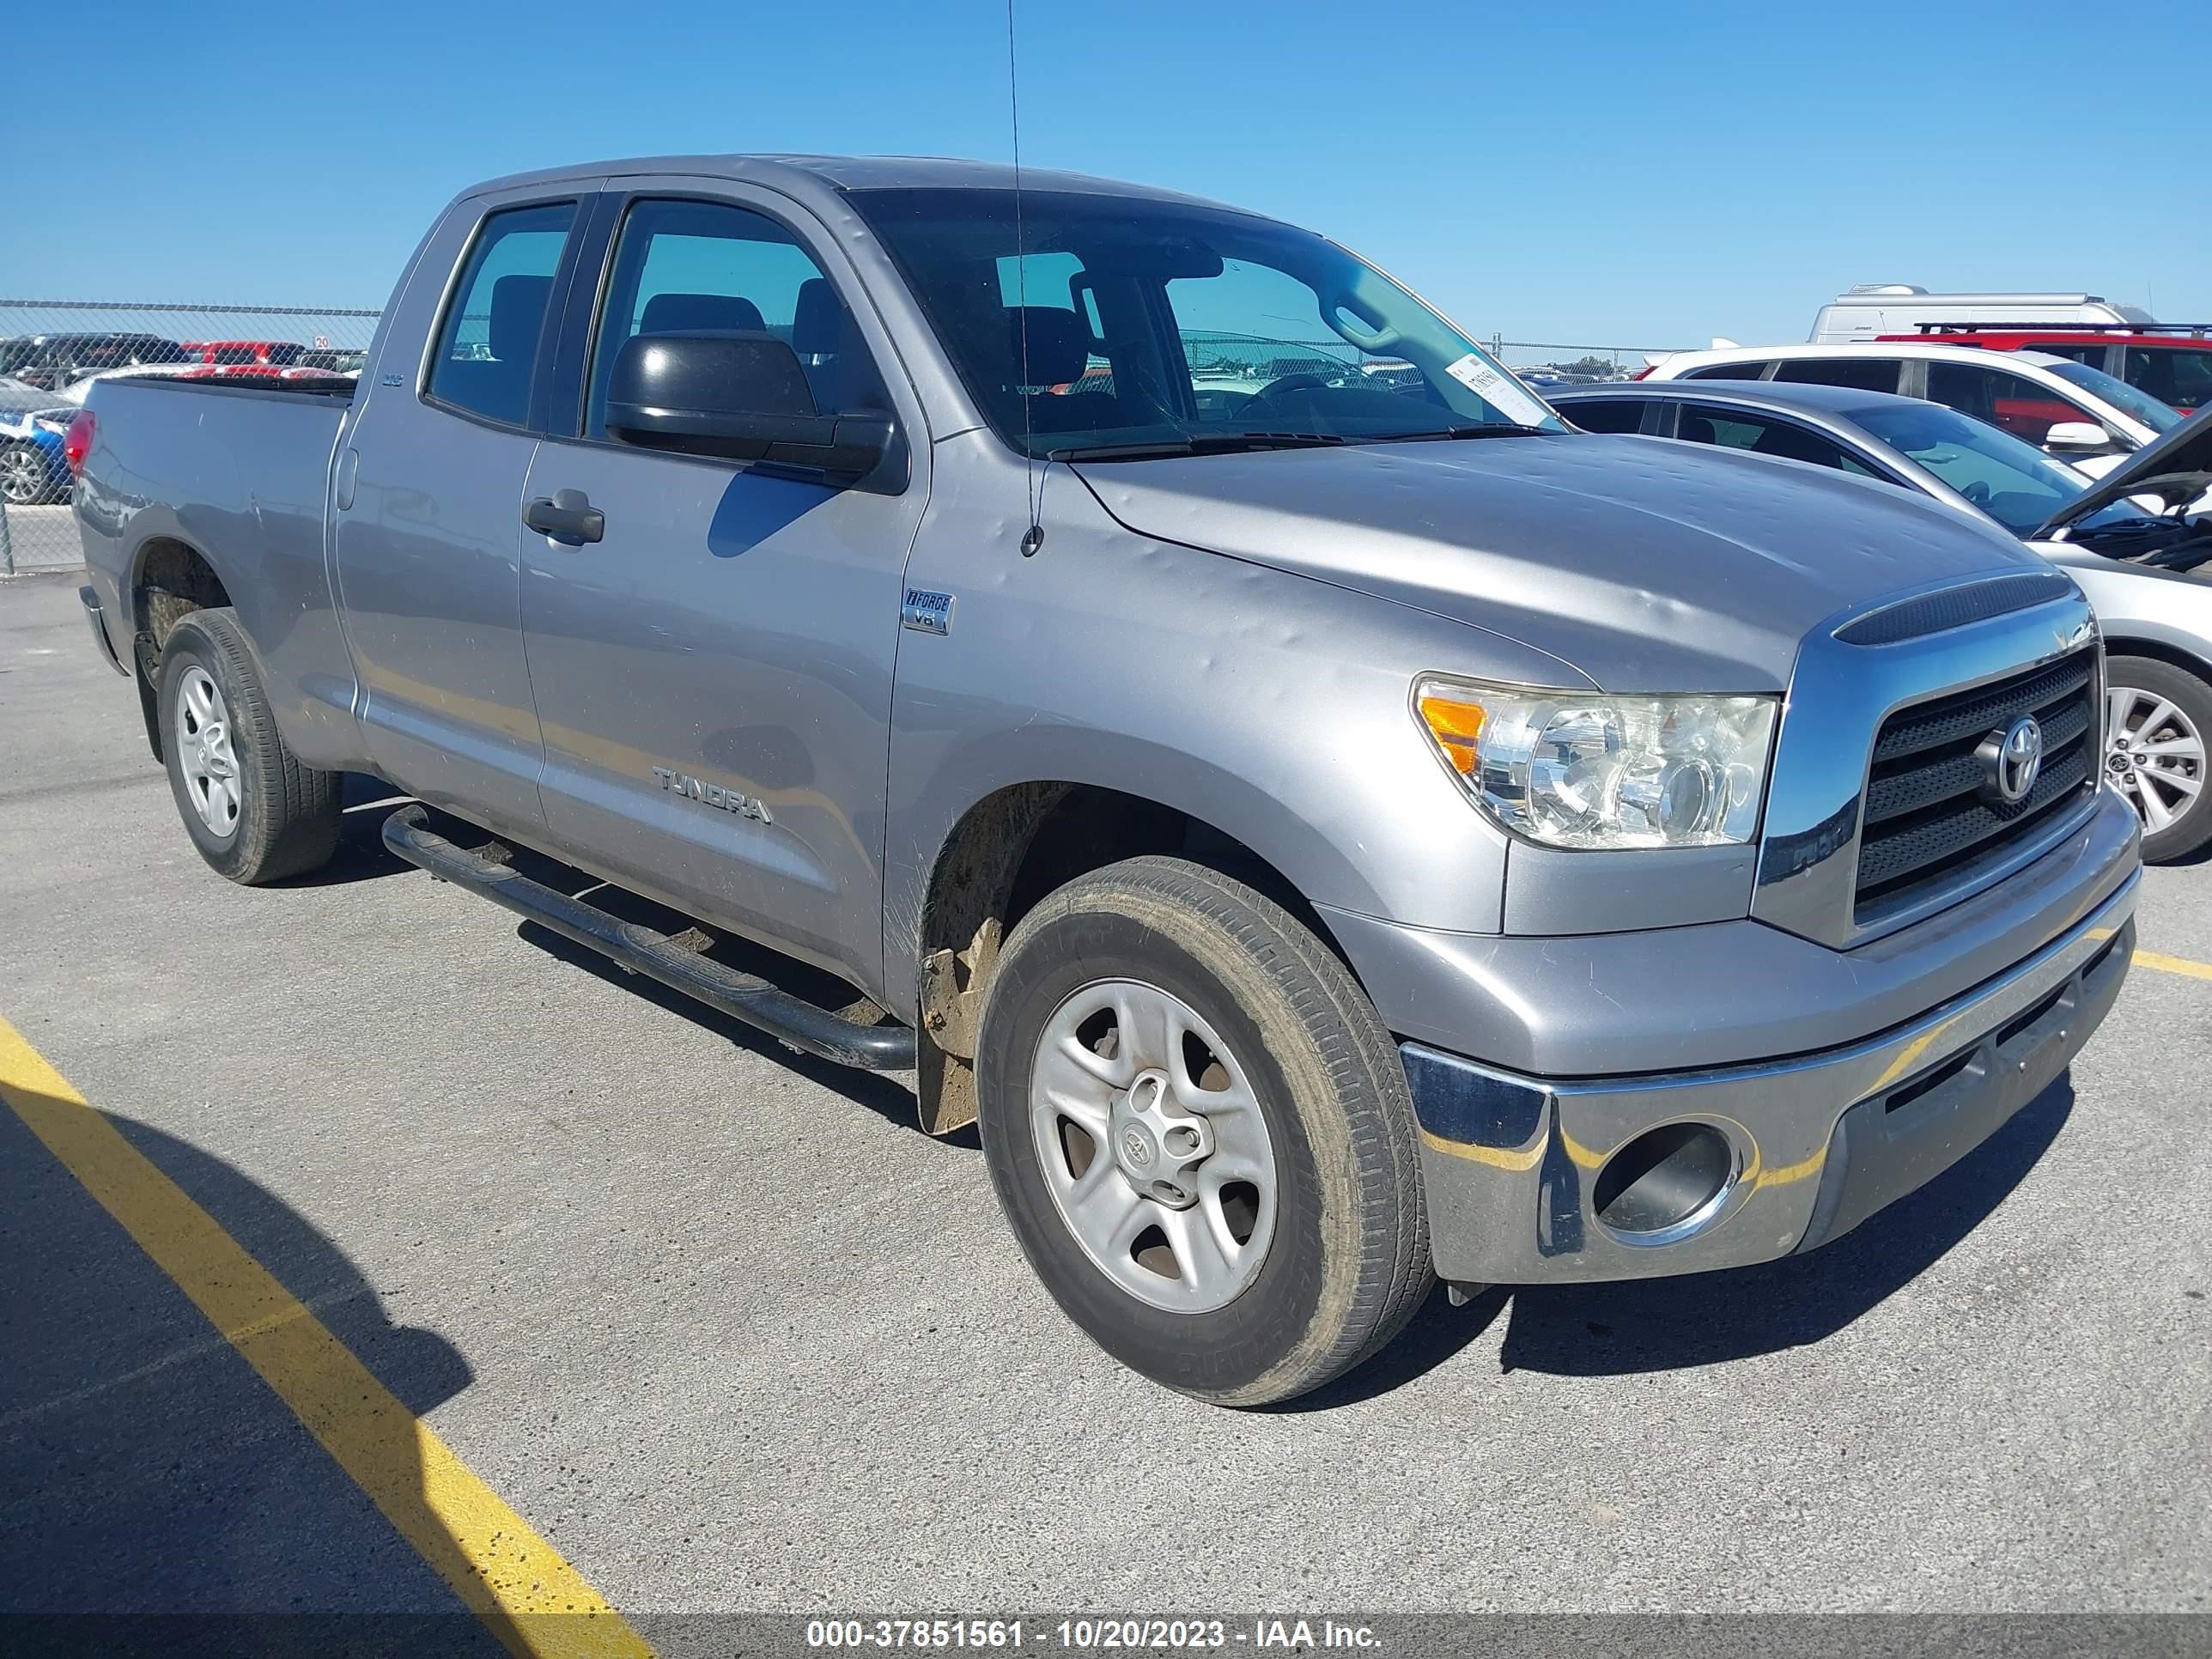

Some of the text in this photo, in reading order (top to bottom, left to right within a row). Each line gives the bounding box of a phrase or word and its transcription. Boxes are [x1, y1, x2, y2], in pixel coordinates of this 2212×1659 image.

[316, 337, 329, 348] 20
[914, 609, 935, 627] V8
[653, 766, 772, 824] TUNDRA
